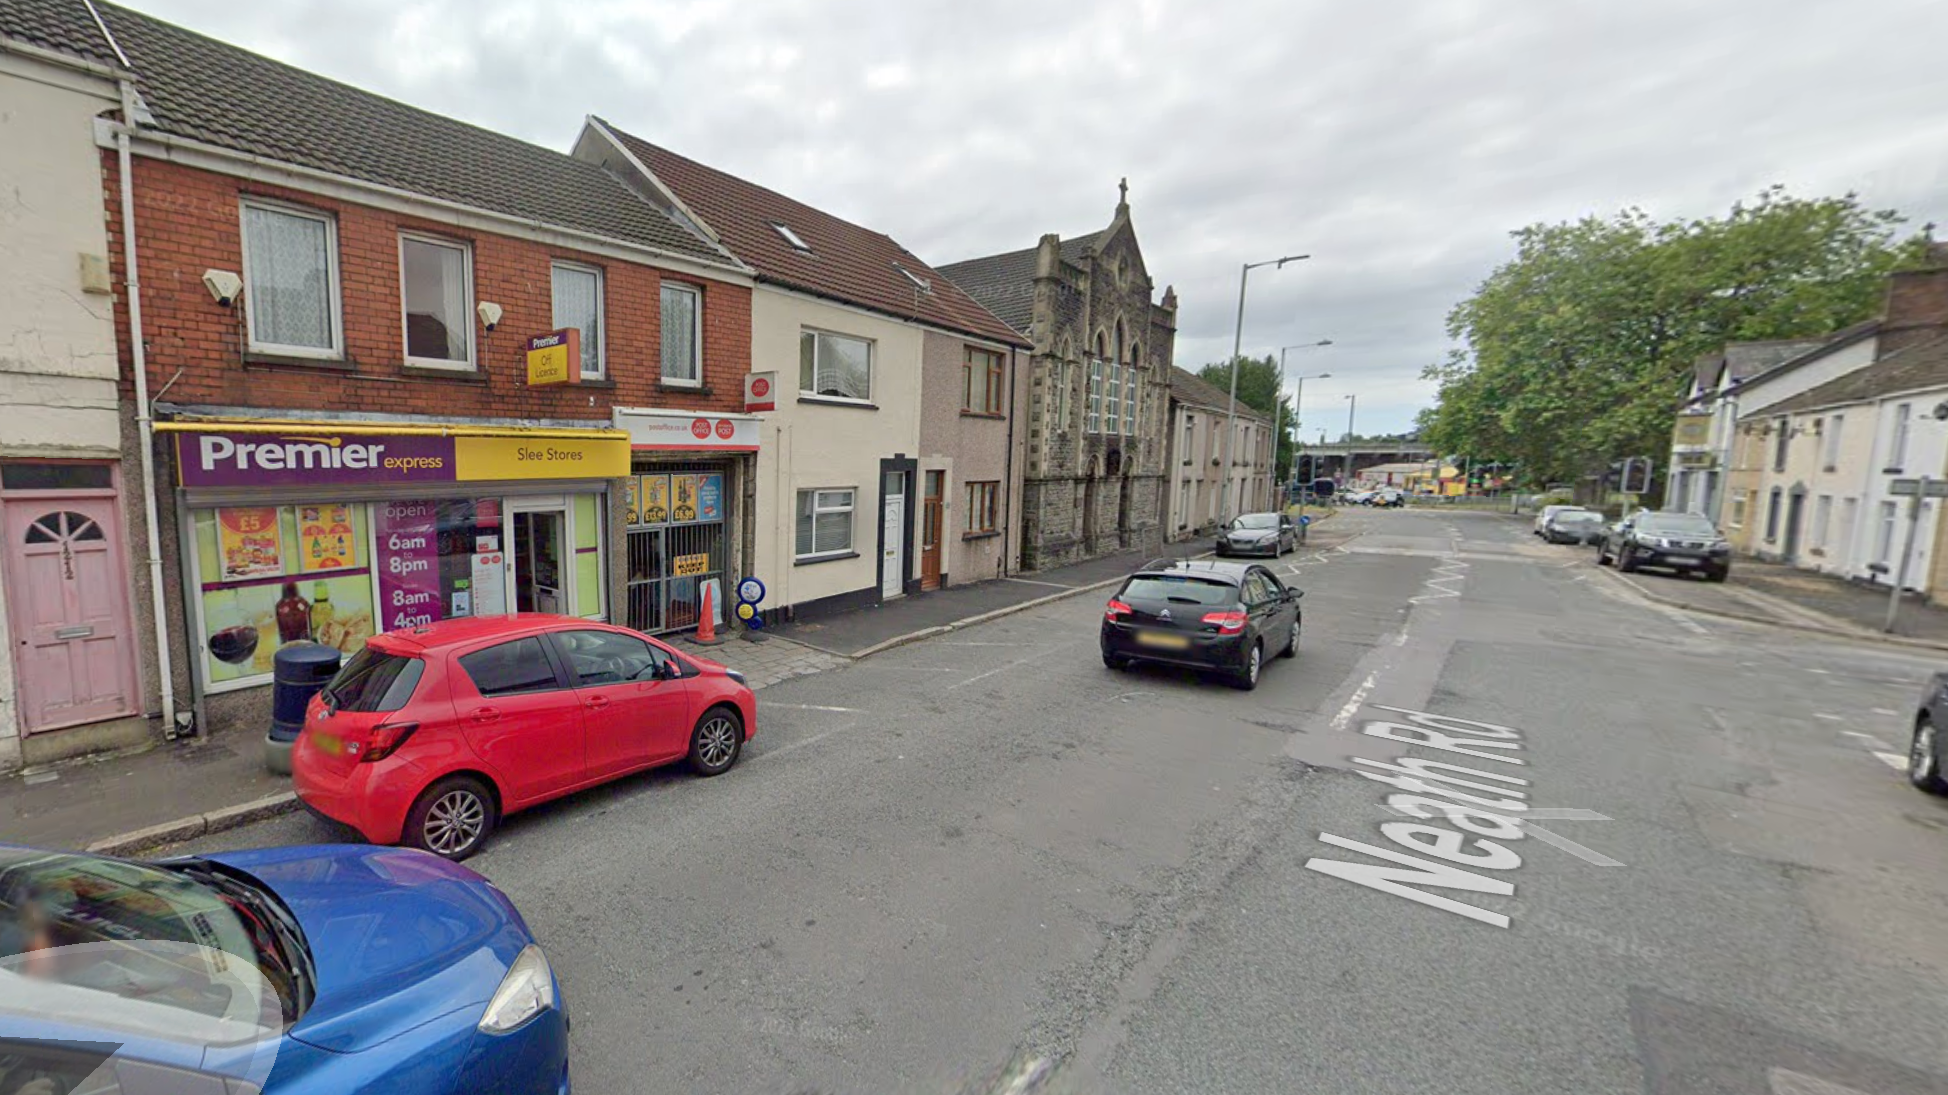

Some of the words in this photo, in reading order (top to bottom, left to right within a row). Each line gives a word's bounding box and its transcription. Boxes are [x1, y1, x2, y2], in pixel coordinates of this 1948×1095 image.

[533, 335, 560, 348] Premier
[541, 354, 552, 366] Off
[535, 367, 559, 378] Licence
[648, 423, 688, 432] postoffice.co.uk
[693, 427, 709, 435] OFFICE
[199, 435, 384, 470] Premier
[383, 455, 443, 473] express
[517, 448, 544, 461] Slee
[546, 448, 583, 461] Stores
[385, 506, 426, 521] open
[239, 516, 259, 531] £5
[388, 534, 426, 550] 6am
[403, 551, 413, 559] to
[389, 557, 428, 576] 8pm
[392, 590, 430, 606] 8am
[406, 606, 417, 614] to
[394, 612, 432, 628] 4pm
